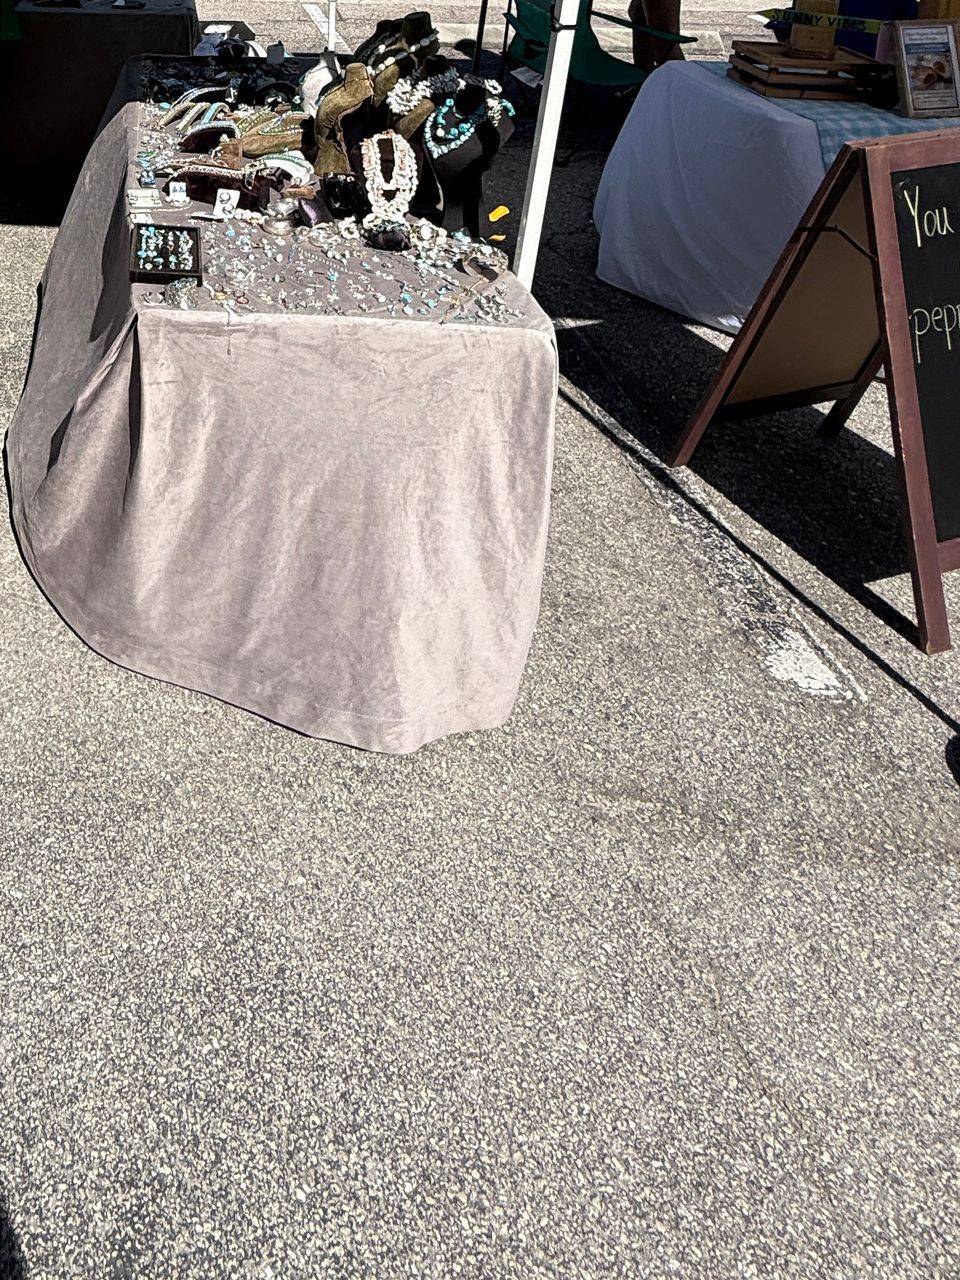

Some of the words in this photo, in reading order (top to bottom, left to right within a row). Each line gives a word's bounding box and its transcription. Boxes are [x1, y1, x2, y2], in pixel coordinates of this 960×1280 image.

[771, 9, 823, 26] SUNNY
[827, 16, 867, 32] VIBES
[903, 185, 955, 247] You
[909, 304, 960, 364] pep
